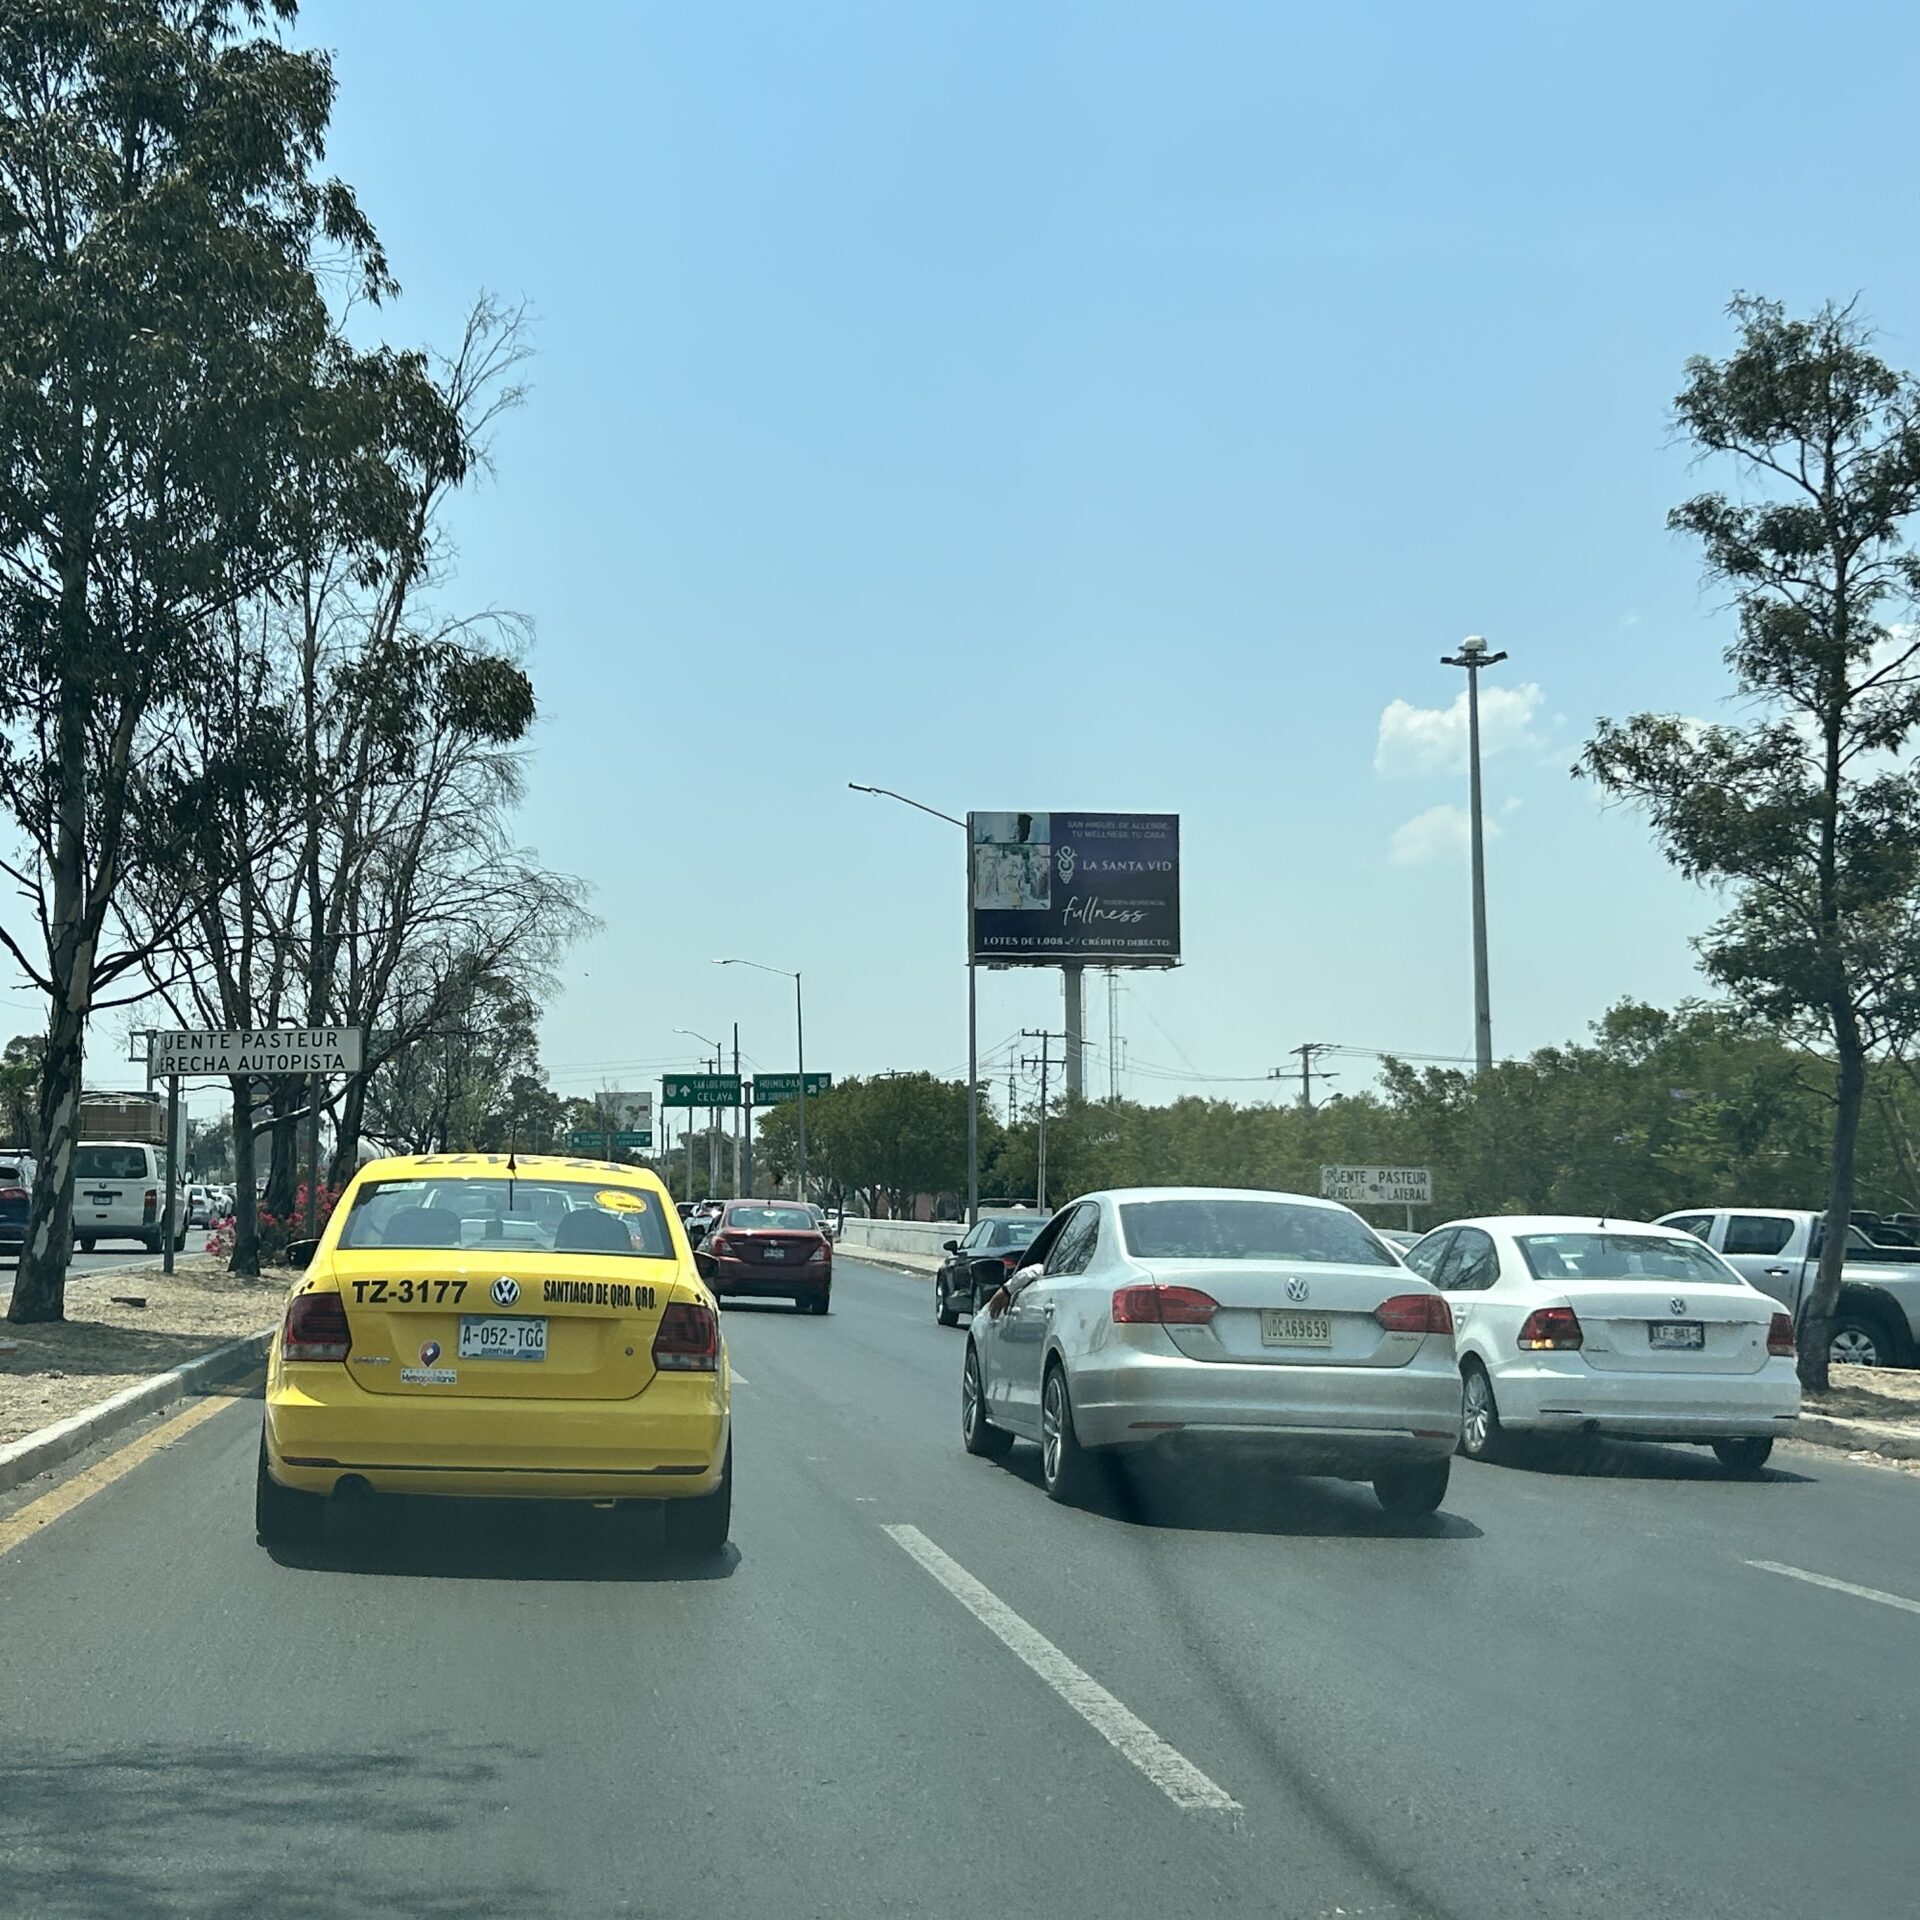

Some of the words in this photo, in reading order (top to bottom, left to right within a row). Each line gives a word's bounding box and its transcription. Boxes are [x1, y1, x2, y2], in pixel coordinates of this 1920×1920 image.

[1083, 861, 1097, 870] LA
[1102, 861, 1143, 871] SANTA
[1147, 861, 1172, 871] VID
[1062, 896, 1147, 926] fullness
[984, 936, 1018, 946] LOTES
[1020, 937, 1035, 946] DE
[161, 1034, 231, 1049] UENTE
[242, 1032, 337, 1048] PASTEUR
[237, 1054, 345, 1071] AUTOPISTA
[697, 1092, 733, 1101] CELAYA
[1378, 1170, 1427, 1185] PASTEUR
[1387, 1187, 1427, 1201] LATERAL
[352, 1280, 468, 1304] TZ-3177
[543, 1279, 594, 1304] SANTIAGO
[595, 1282, 609, 1305] DE
[610, 1283, 634, 1309] QRO.
[635, 1285, 658, 1311] QRO.
[463, 1325, 544, 1347] A-052-TGG
